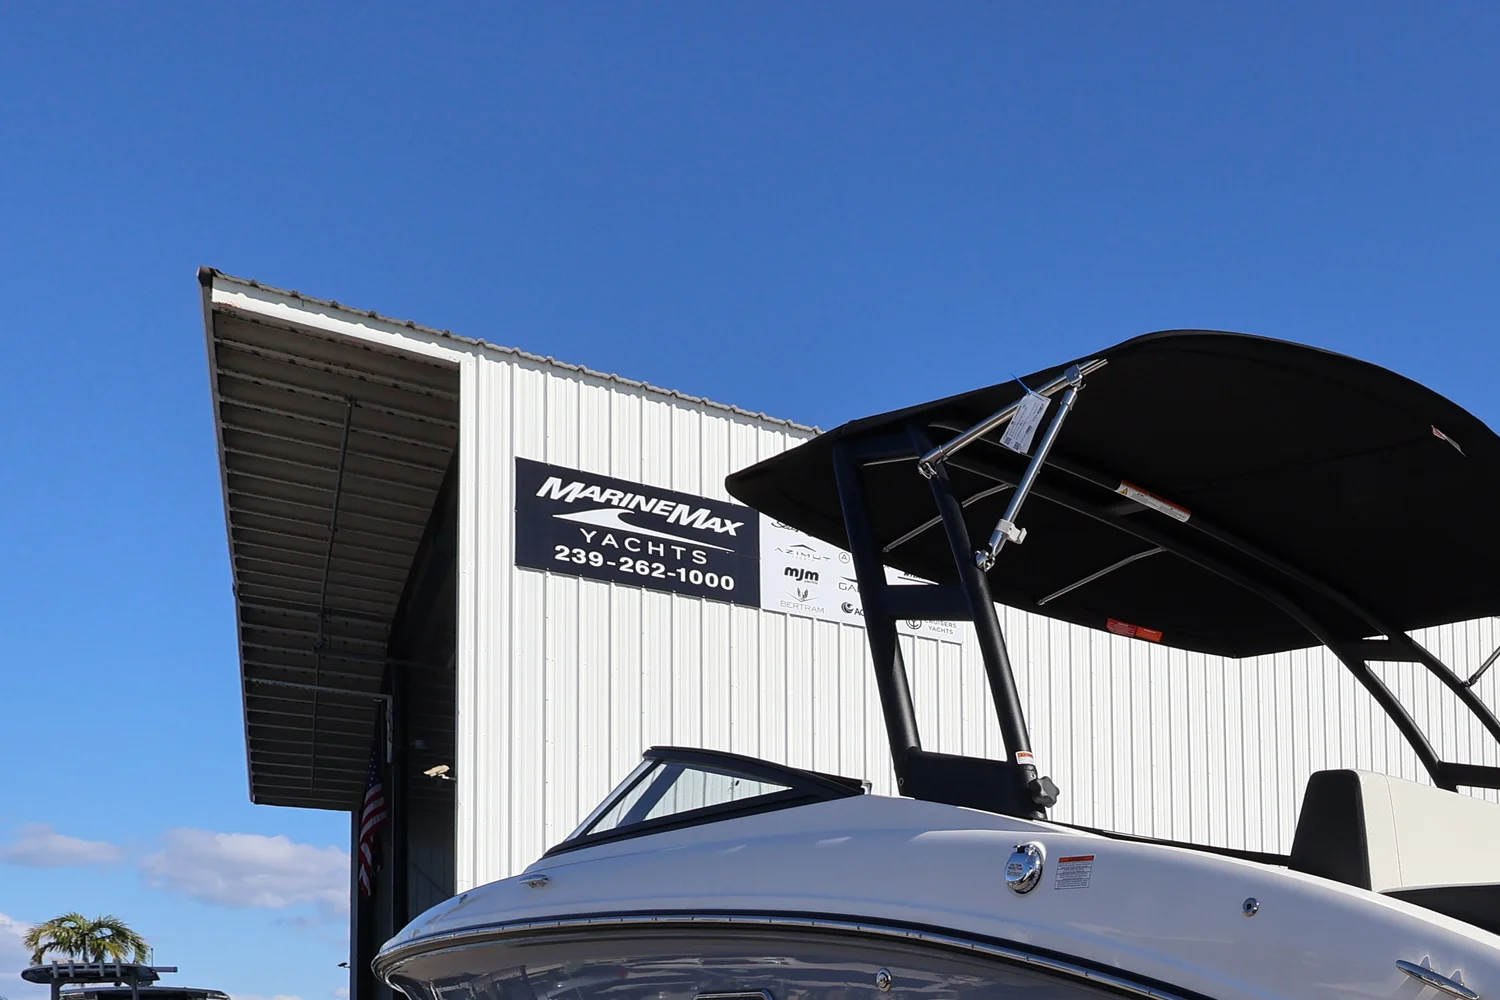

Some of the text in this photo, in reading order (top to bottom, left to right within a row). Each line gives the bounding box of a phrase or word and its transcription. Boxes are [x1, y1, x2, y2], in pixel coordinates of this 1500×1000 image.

[580, 528, 708, 565] YACHTS
[774, 547, 831, 562] AZIMUT
[554, 545, 736, 592] 239-262-1000
[780, 600, 825, 613] BERTRAM
[928, 626, 954, 635] YACHTS
